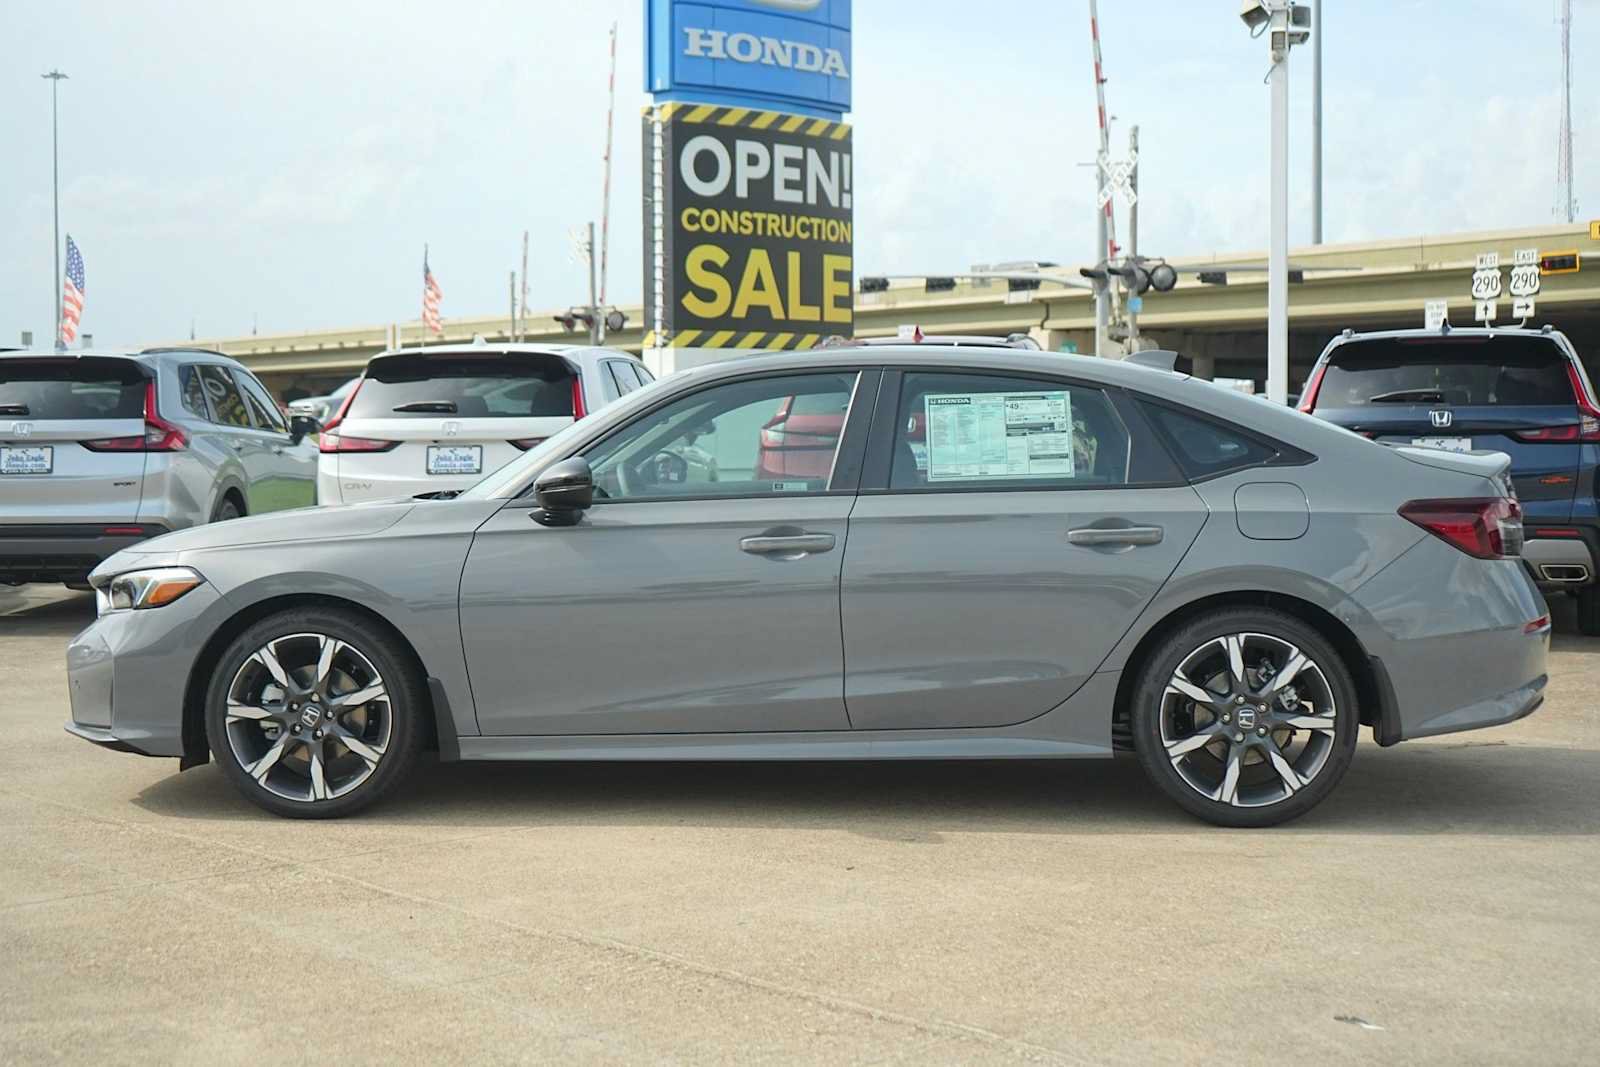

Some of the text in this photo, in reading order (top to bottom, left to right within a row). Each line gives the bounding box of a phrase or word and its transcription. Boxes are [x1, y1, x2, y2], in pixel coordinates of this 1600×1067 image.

[683, 27, 849, 79] HONDA
[680, 135, 852, 209] OPEN!
[681, 207, 852, 243] CONSTRUCTION
[1516, 251, 1535, 262] EAST
[681, 244, 852, 324] SALE
[1475, 275, 1498, 293] 290
[1512, 271, 1537, 289] 290
